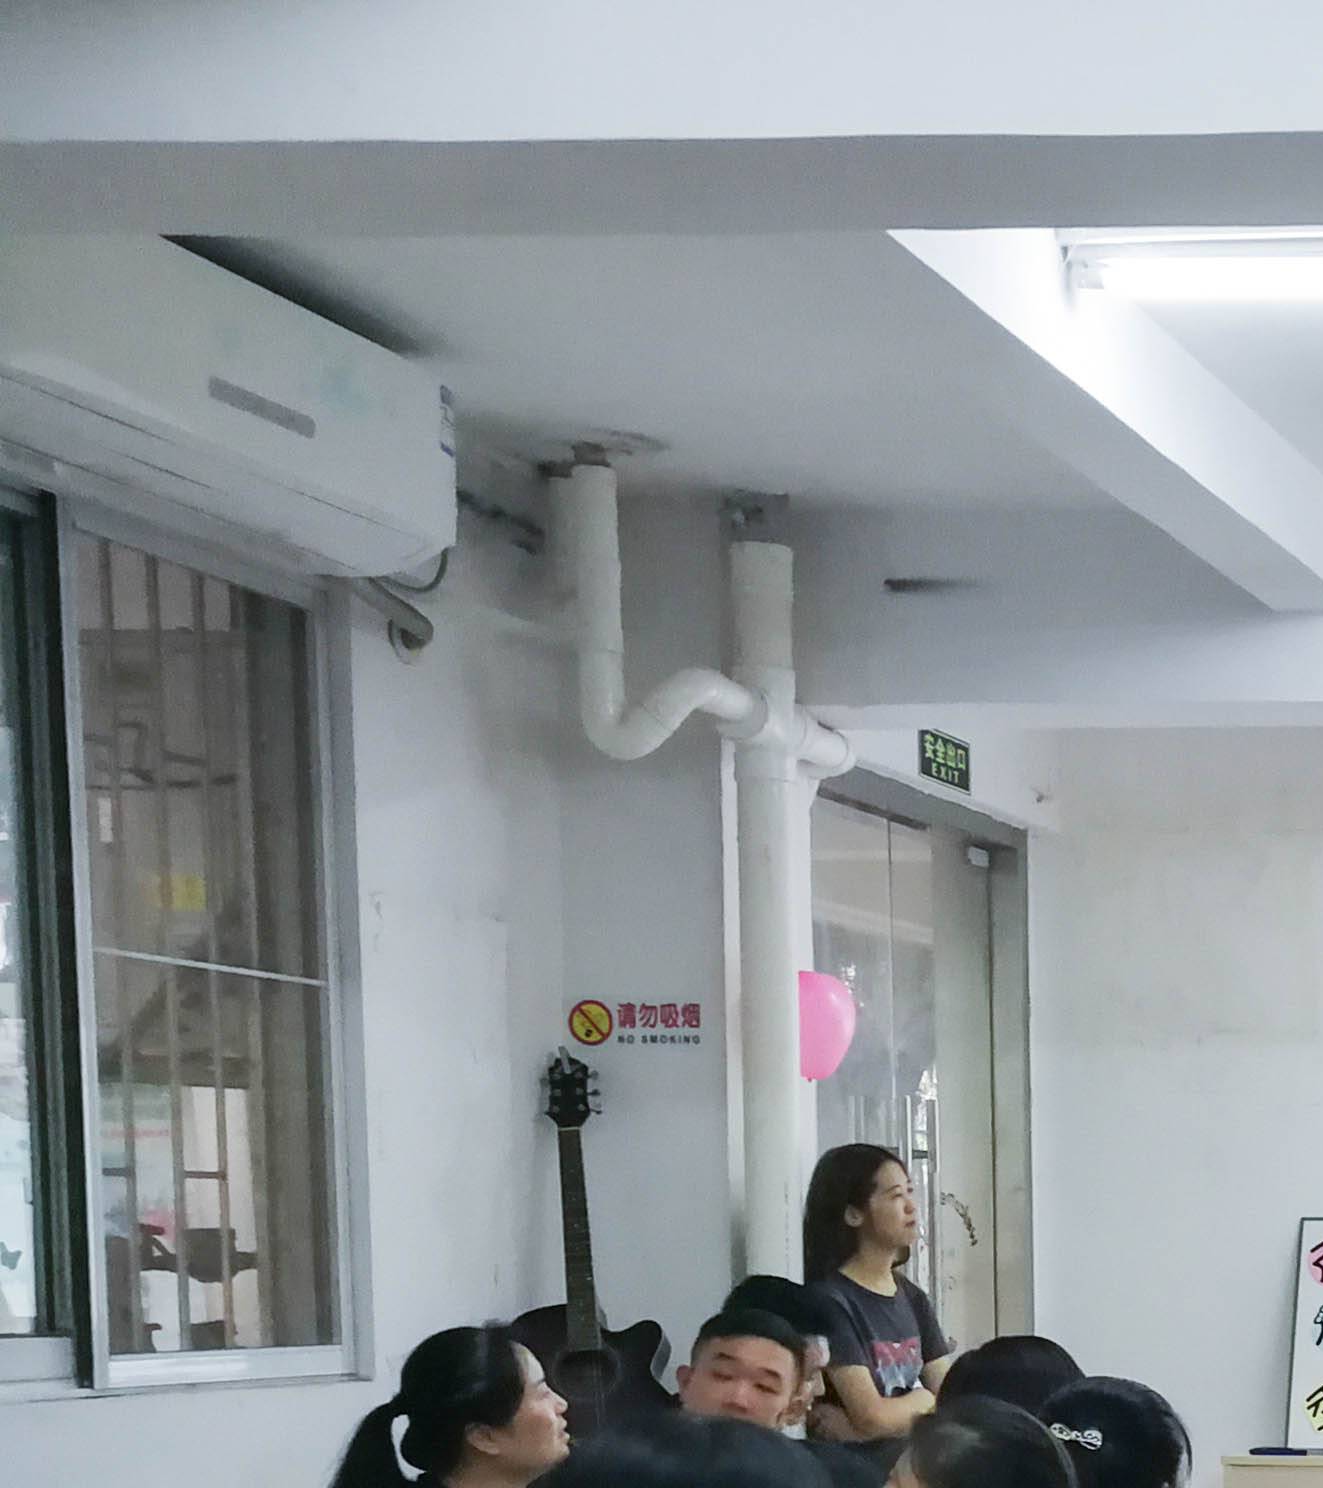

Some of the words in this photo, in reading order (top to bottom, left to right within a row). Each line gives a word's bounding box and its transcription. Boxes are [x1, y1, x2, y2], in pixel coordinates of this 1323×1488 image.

[931, 762, 959, 784] EXIT
[618, 1003, 700, 1028] 请勿吸烟
[617, 1034, 635, 1044] NO
[641, 1034, 701, 1045] SMOKING
